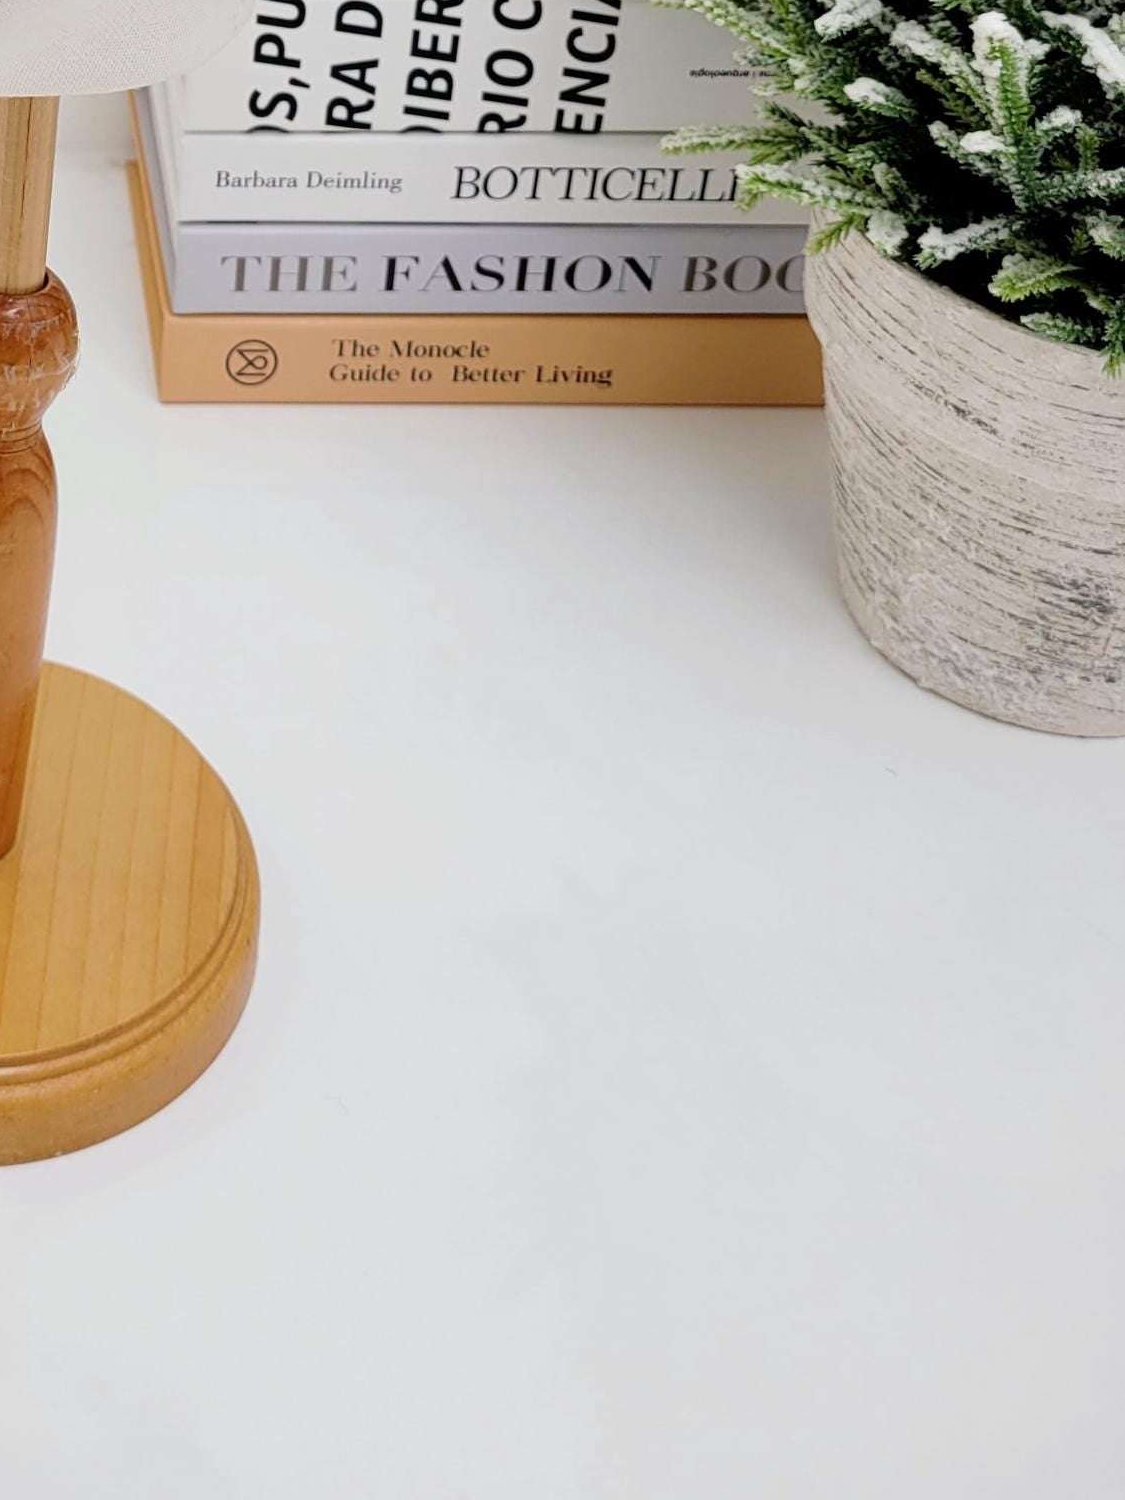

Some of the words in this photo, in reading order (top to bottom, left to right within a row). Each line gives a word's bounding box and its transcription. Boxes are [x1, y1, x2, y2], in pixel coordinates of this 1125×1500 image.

[242, 76, 310, 133] S,
[321, 59, 380, 133] RA
[215, 170, 298, 189] Barbara
[306, 171, 403, 193] Deimling
[450, 165, 738, 202] BOTTICELLI
[220, 254, 358, 292] THE
[379, 253, 663, 293] FASHON
[331, 338, 380, 358] The
[389, 339, 491, 358] Monocle
[329, 363, 400, 382] Guide
[410, 365, 432, 382] to
[451, 364, 526, 383] Better
[535, 364, 614, 387] Living
